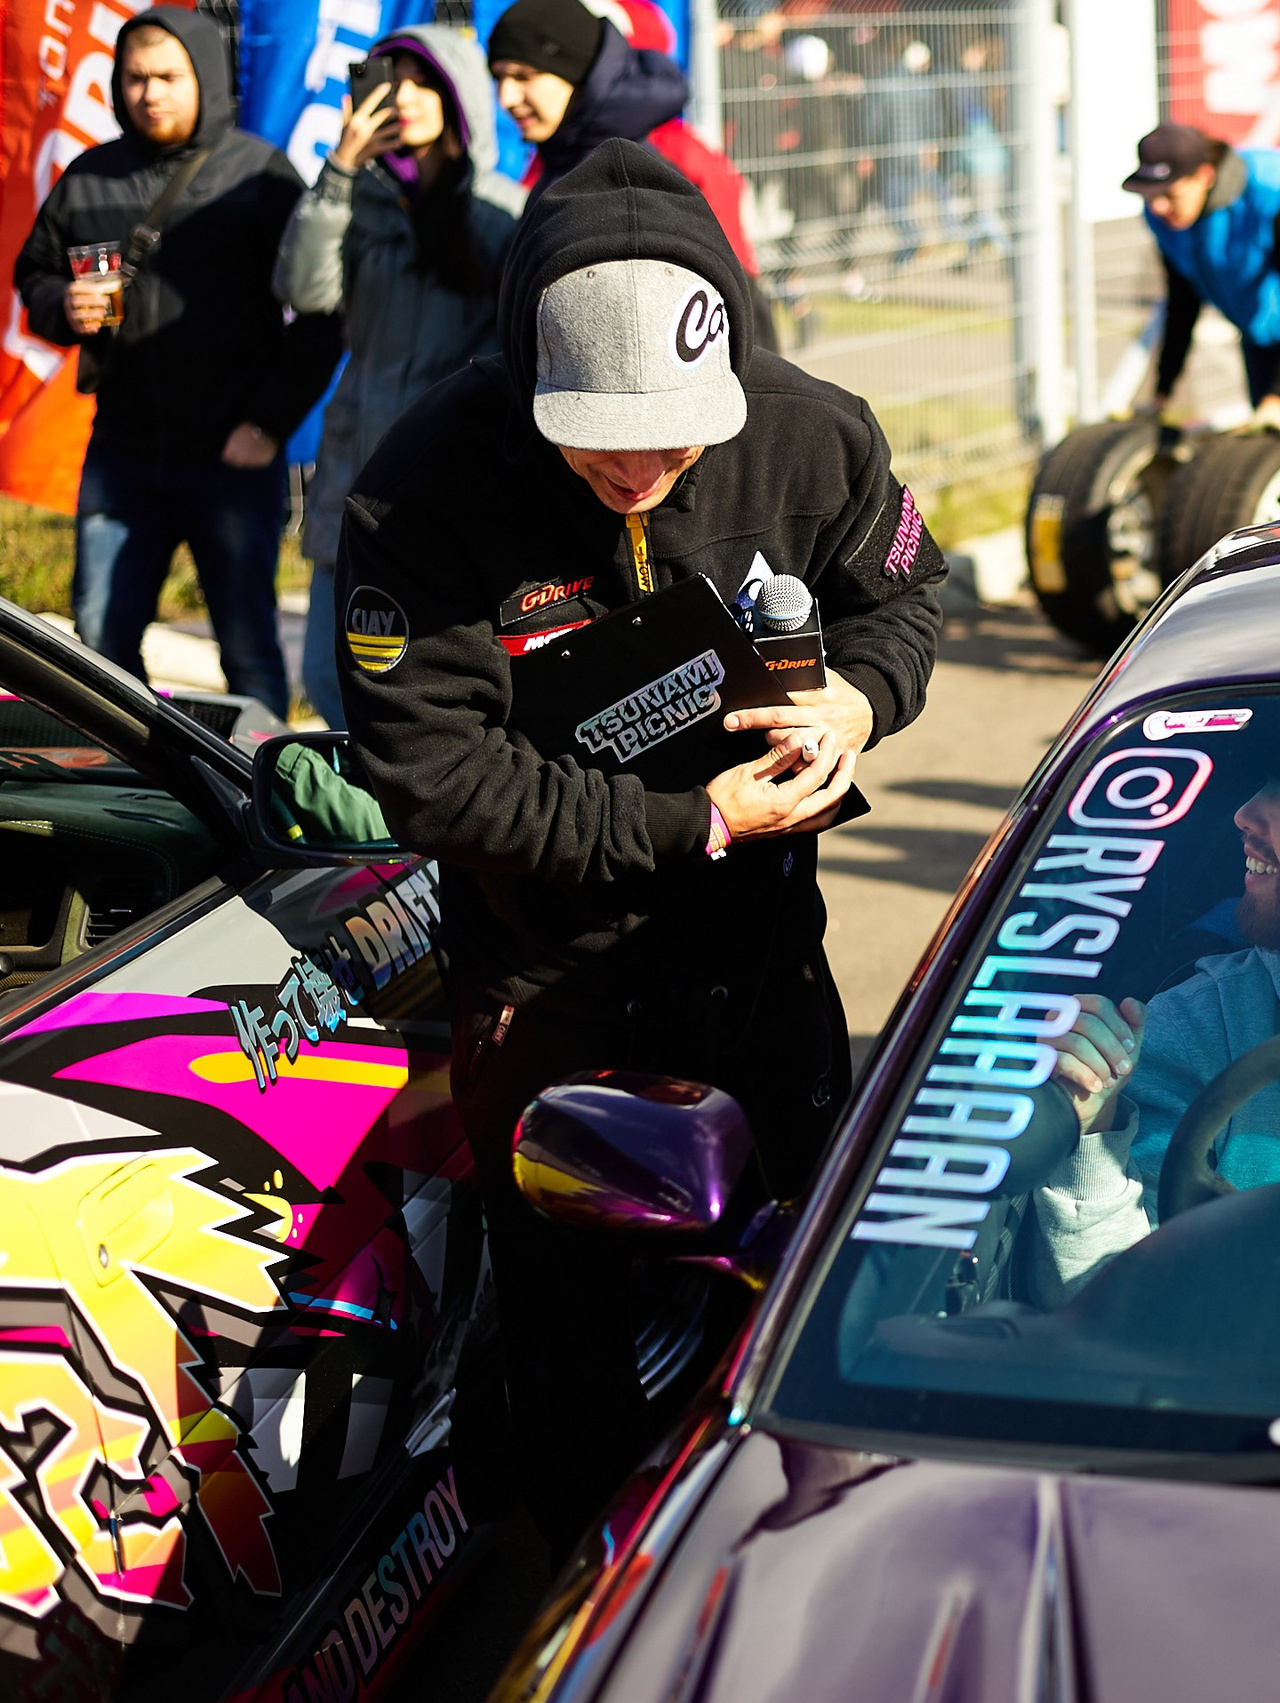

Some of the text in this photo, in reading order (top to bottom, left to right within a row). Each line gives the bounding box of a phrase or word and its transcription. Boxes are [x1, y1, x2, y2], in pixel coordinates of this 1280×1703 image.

[884, 487, 914, 574] TSUNAMI
[899, 508, 923, 575] PICNIC
[583, 652, 719, 742] TSUNAMI
[616, 685, 716, 752] PICNIC
[850, 834, 1165, 1250] RYSLAAAAN
[343, 1465, 469, 1675] DESTROY
